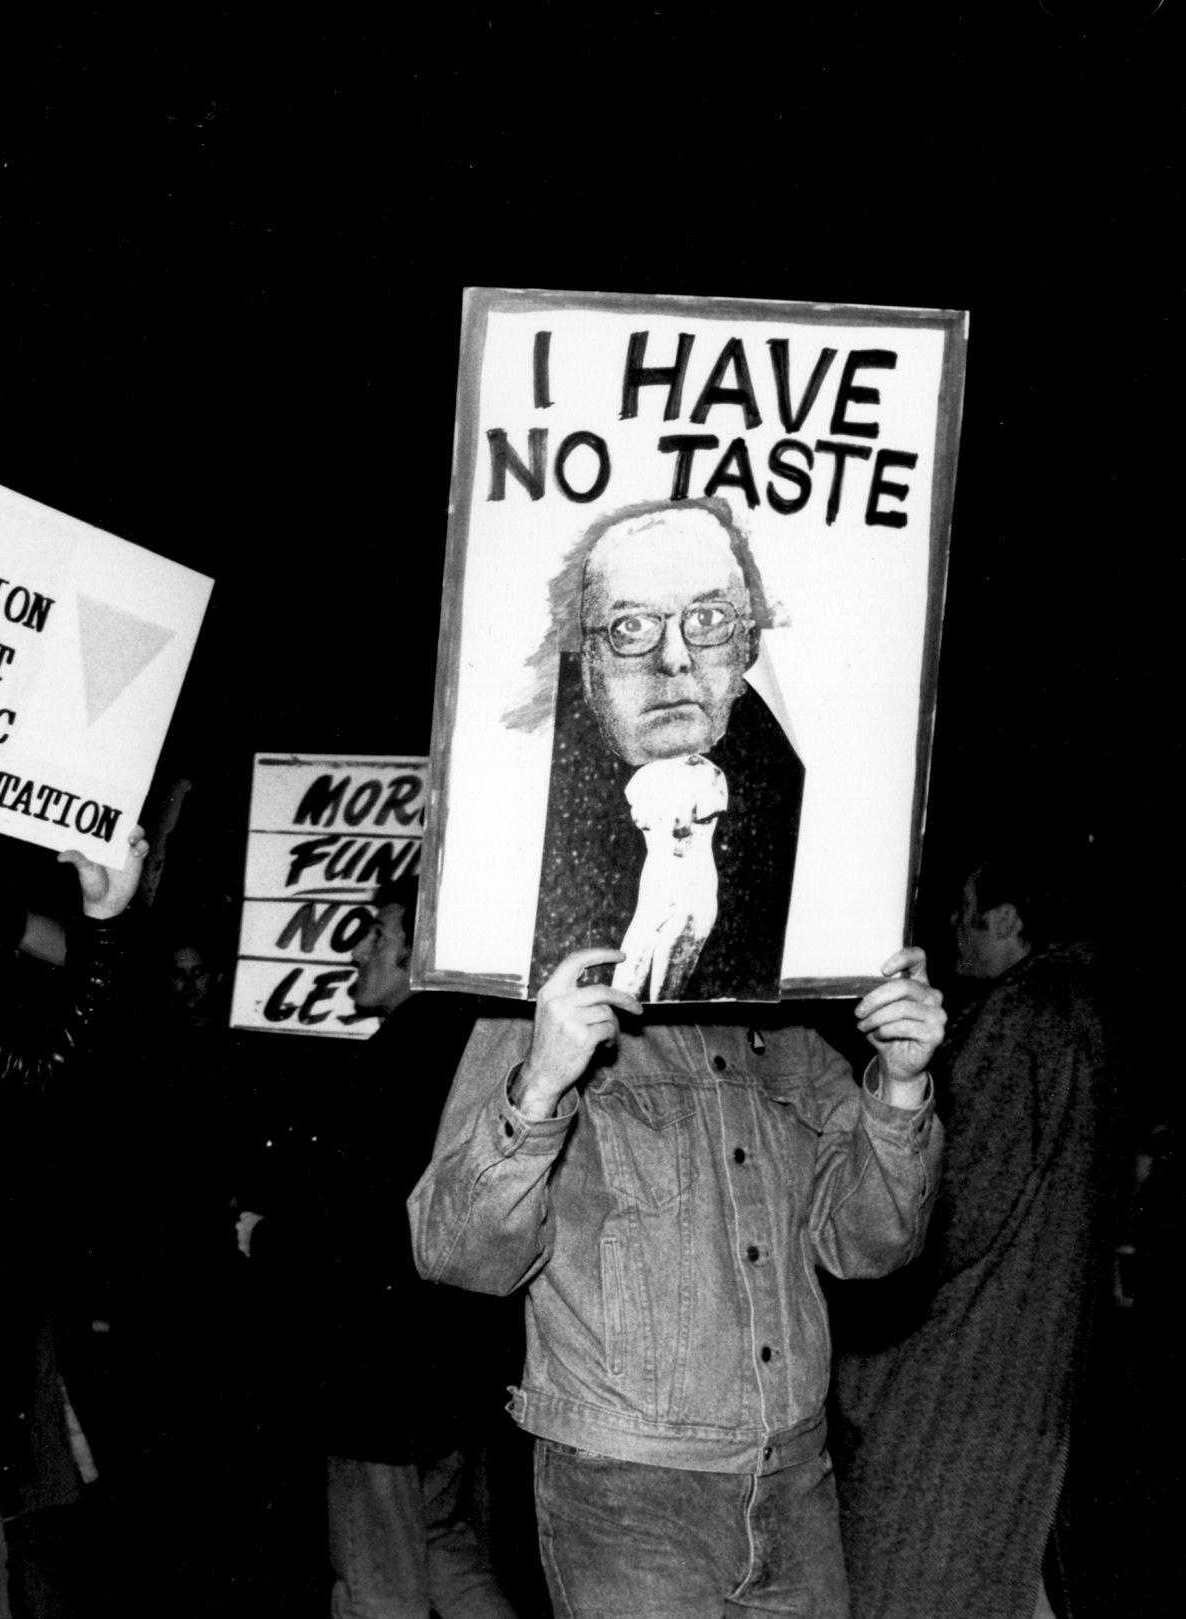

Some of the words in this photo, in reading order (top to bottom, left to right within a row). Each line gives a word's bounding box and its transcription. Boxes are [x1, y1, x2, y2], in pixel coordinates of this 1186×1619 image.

[533, 331, 555, 409] I
[620, 331, 898, 438] HAVE
[486, 427, 611, 504] NO
[658, 433, 918, 528] TASTE
[293, 774, 425, 828] MOR
[275, 902, 374, 953] NO
